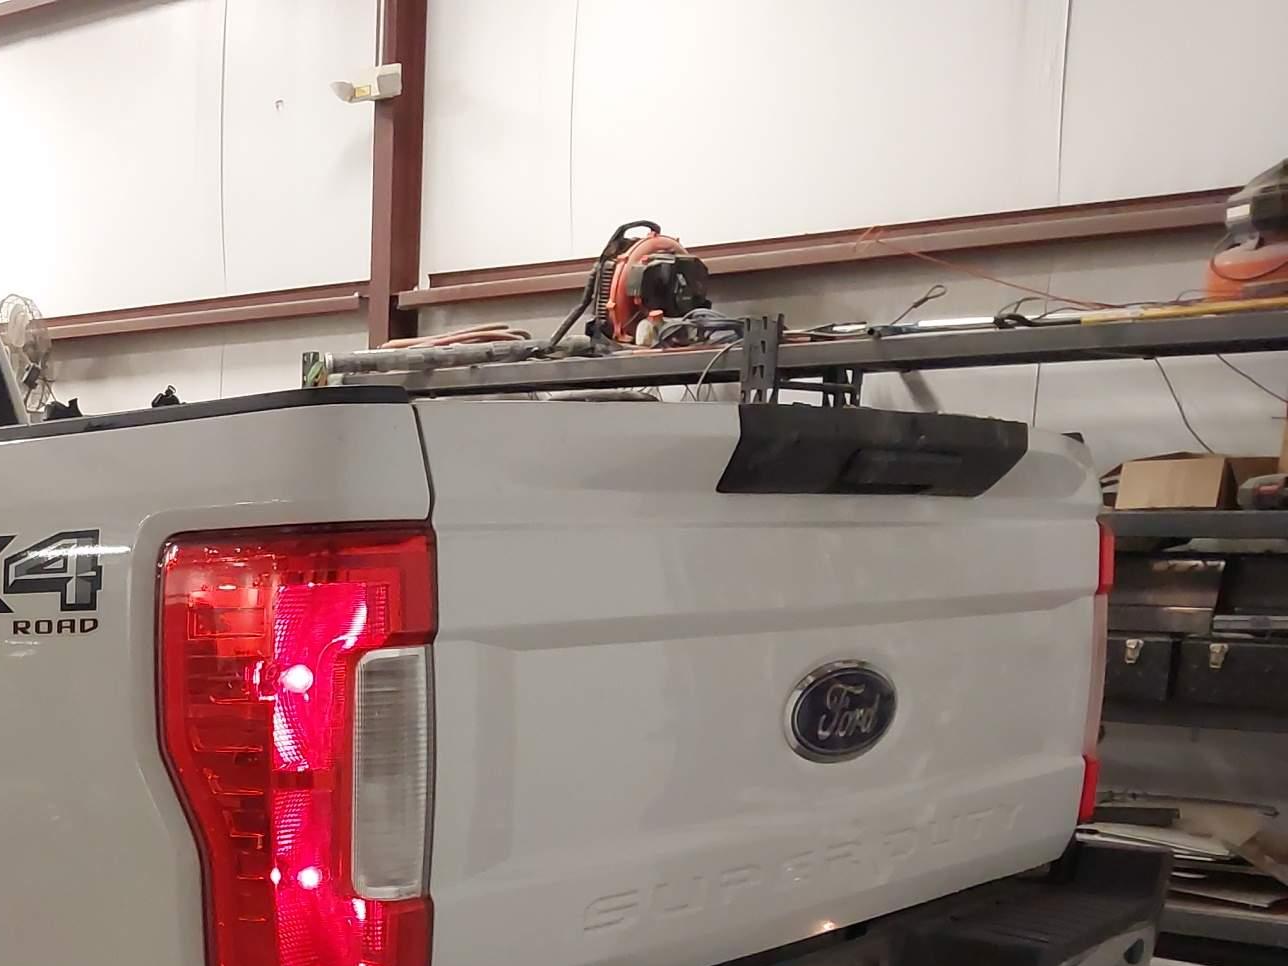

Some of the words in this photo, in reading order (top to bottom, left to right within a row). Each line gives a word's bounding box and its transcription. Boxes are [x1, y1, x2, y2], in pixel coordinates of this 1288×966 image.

[13, 618, 99, 635] ROAD
[815, 682, 881, 741] Ford
[583, 839, 863, 934] SUPER
[881, 802, 1026, 863] DUTY
